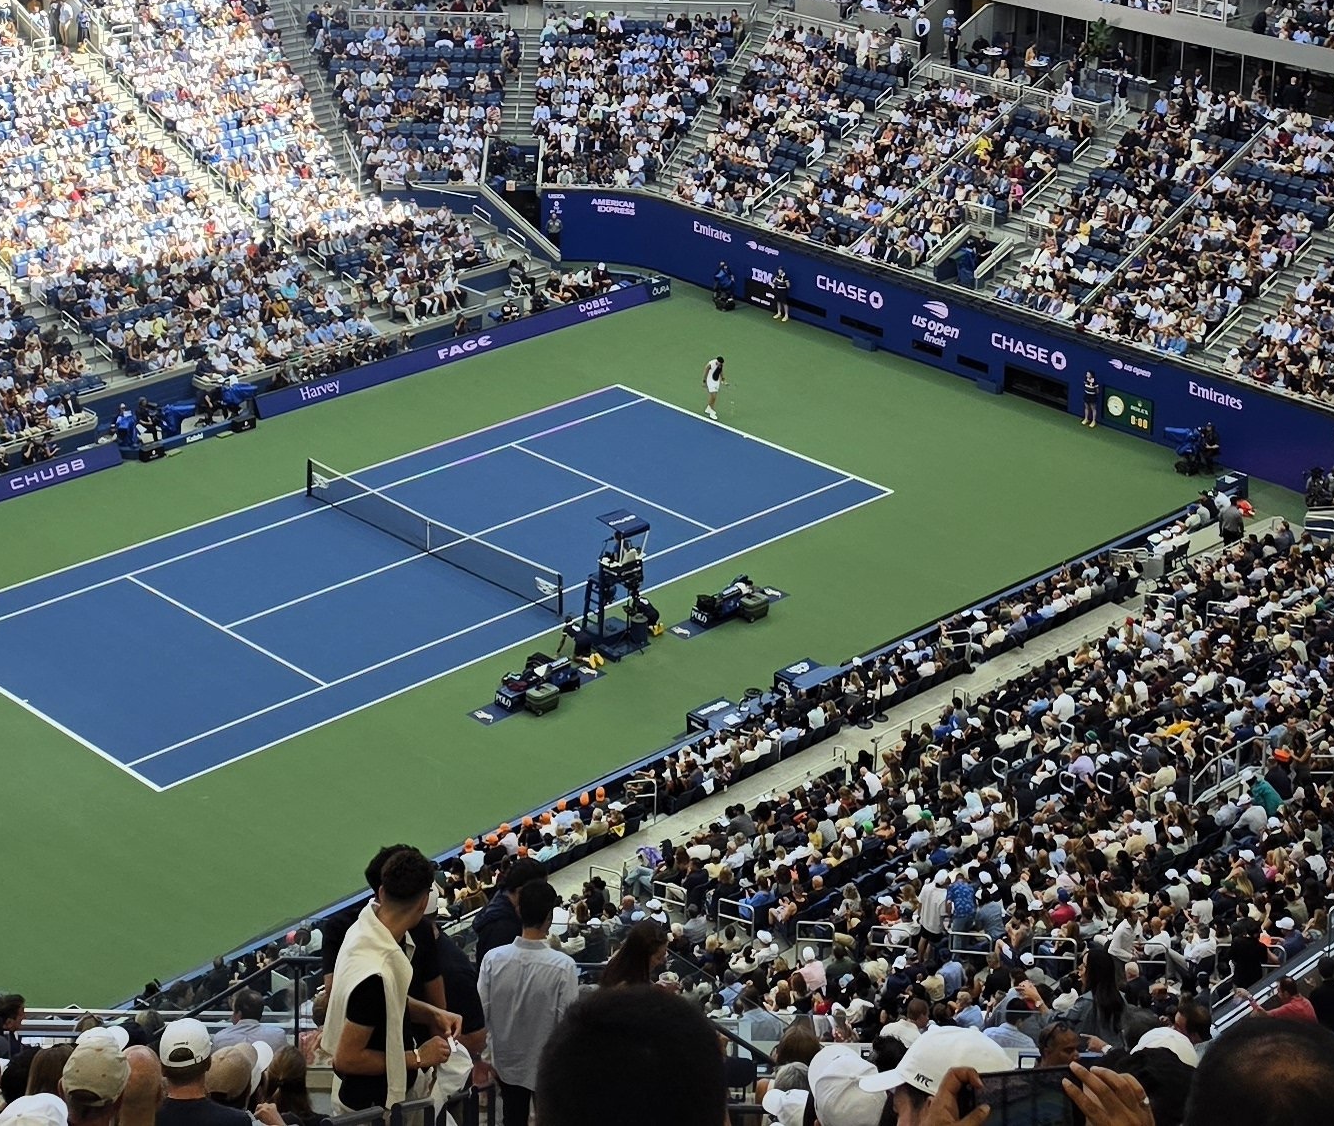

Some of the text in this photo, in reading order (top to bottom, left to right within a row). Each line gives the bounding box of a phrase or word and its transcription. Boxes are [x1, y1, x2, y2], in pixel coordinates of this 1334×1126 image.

[591, 198, 635, 209] AMERICAN
[597, 206, 636, 216] EXPRESS
[693, 220, 732, 243] Emirates
[752, 267, 773, 285] IBM
[816, 274, 867, 304] CHASE
[578, 297, 613, 313] DOBEL
[912, 315, 960, 339] us open
[437, 335, 493, 360] FAGE
[923, 331, 947, 347] finals
[991, 332, 1049, 364] CHASE
[1124, 363, 1152, 378] us open
[299, 380, 340, 401] Harvey
[1188, 380, 1243, 410] Emirates
[9, 458, 85, 490] CHUBB
[914, 1073, 934, 1088] NYC
